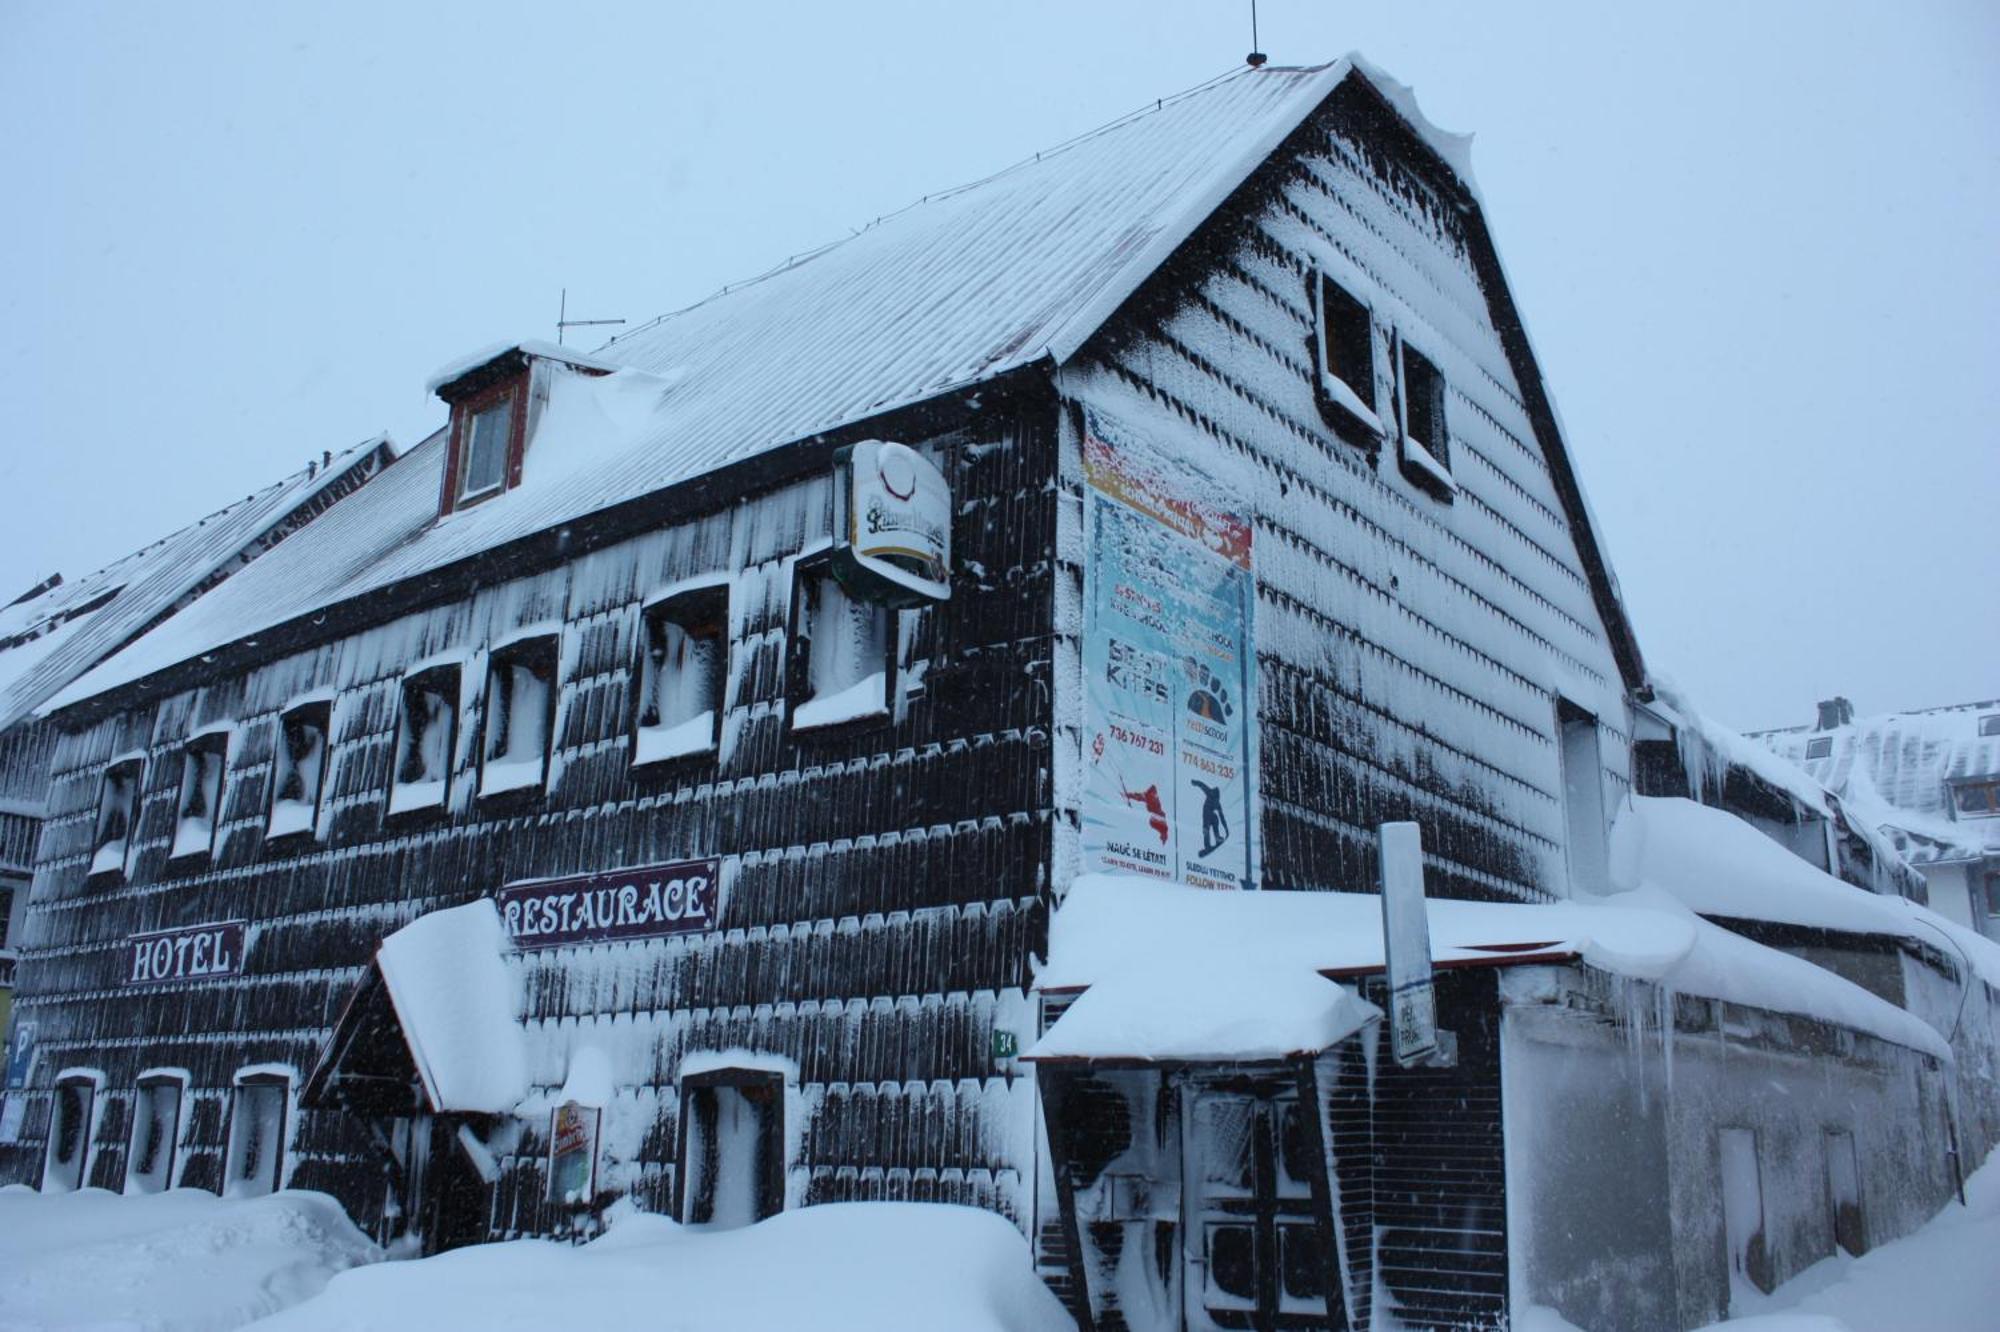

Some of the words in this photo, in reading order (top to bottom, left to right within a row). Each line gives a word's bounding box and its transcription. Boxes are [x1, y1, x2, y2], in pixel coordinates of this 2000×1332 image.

[1109, 724, 1127, 742] 736
[1129, 732, 1146, 748] 767
[1149, 739, 1164, 755] 231
[1182, 751, 1198, 768] 774
[1216, 764, 1234, 780] 235
[1132, 847, 1141, 859] SE
[1185, 874, 1214, 890] FOLLOW
[503, 875, 708, 937] RESTAURACE
[130, 930, 230, 982] HOTEL
[15, 1029, 28, 1064] P
[1000, 1033, 1012, 1053] 34
